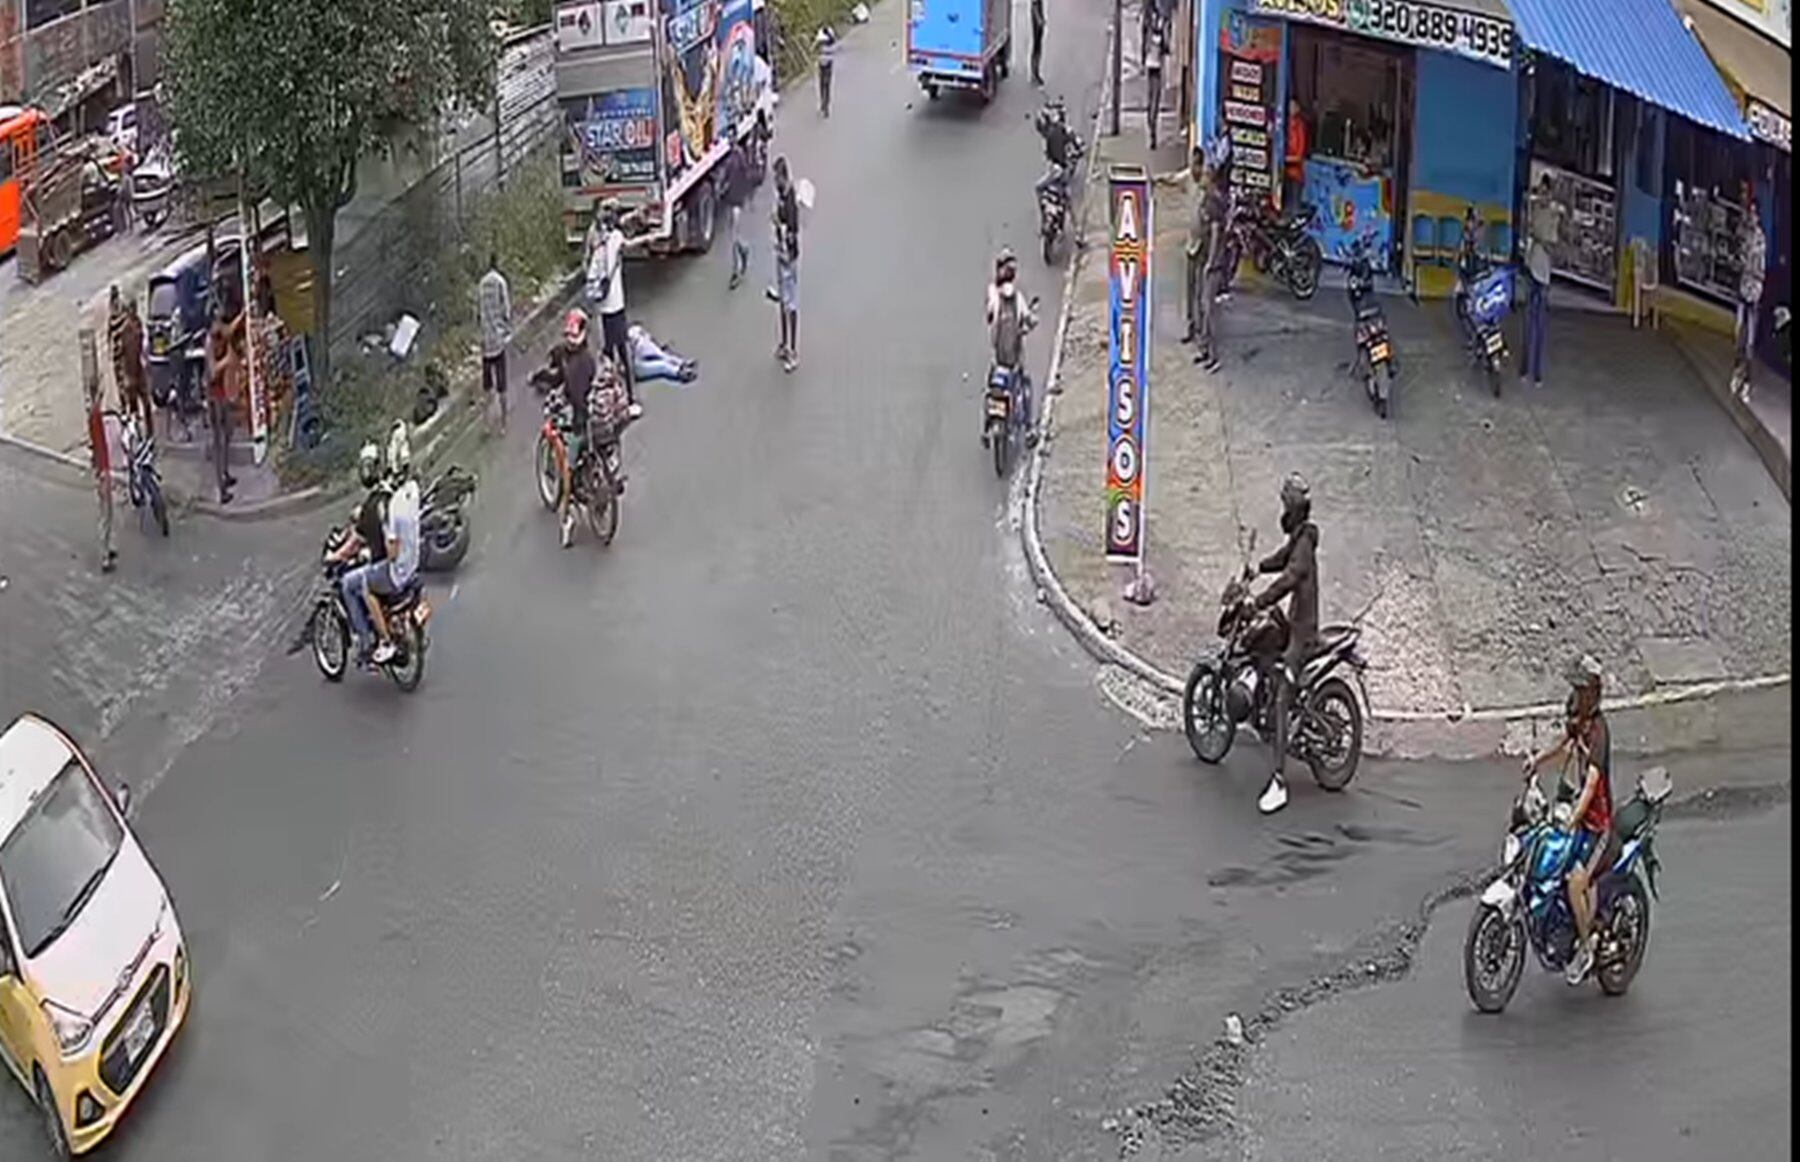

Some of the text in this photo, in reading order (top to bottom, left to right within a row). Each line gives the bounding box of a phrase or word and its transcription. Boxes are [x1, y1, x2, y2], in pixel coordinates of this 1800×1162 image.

[1370, 0, 1514, 59] 320 889 4939
[587, 118, 654, 148] STAR OIL
[1113, 192, 1139, 544] AVISOS
